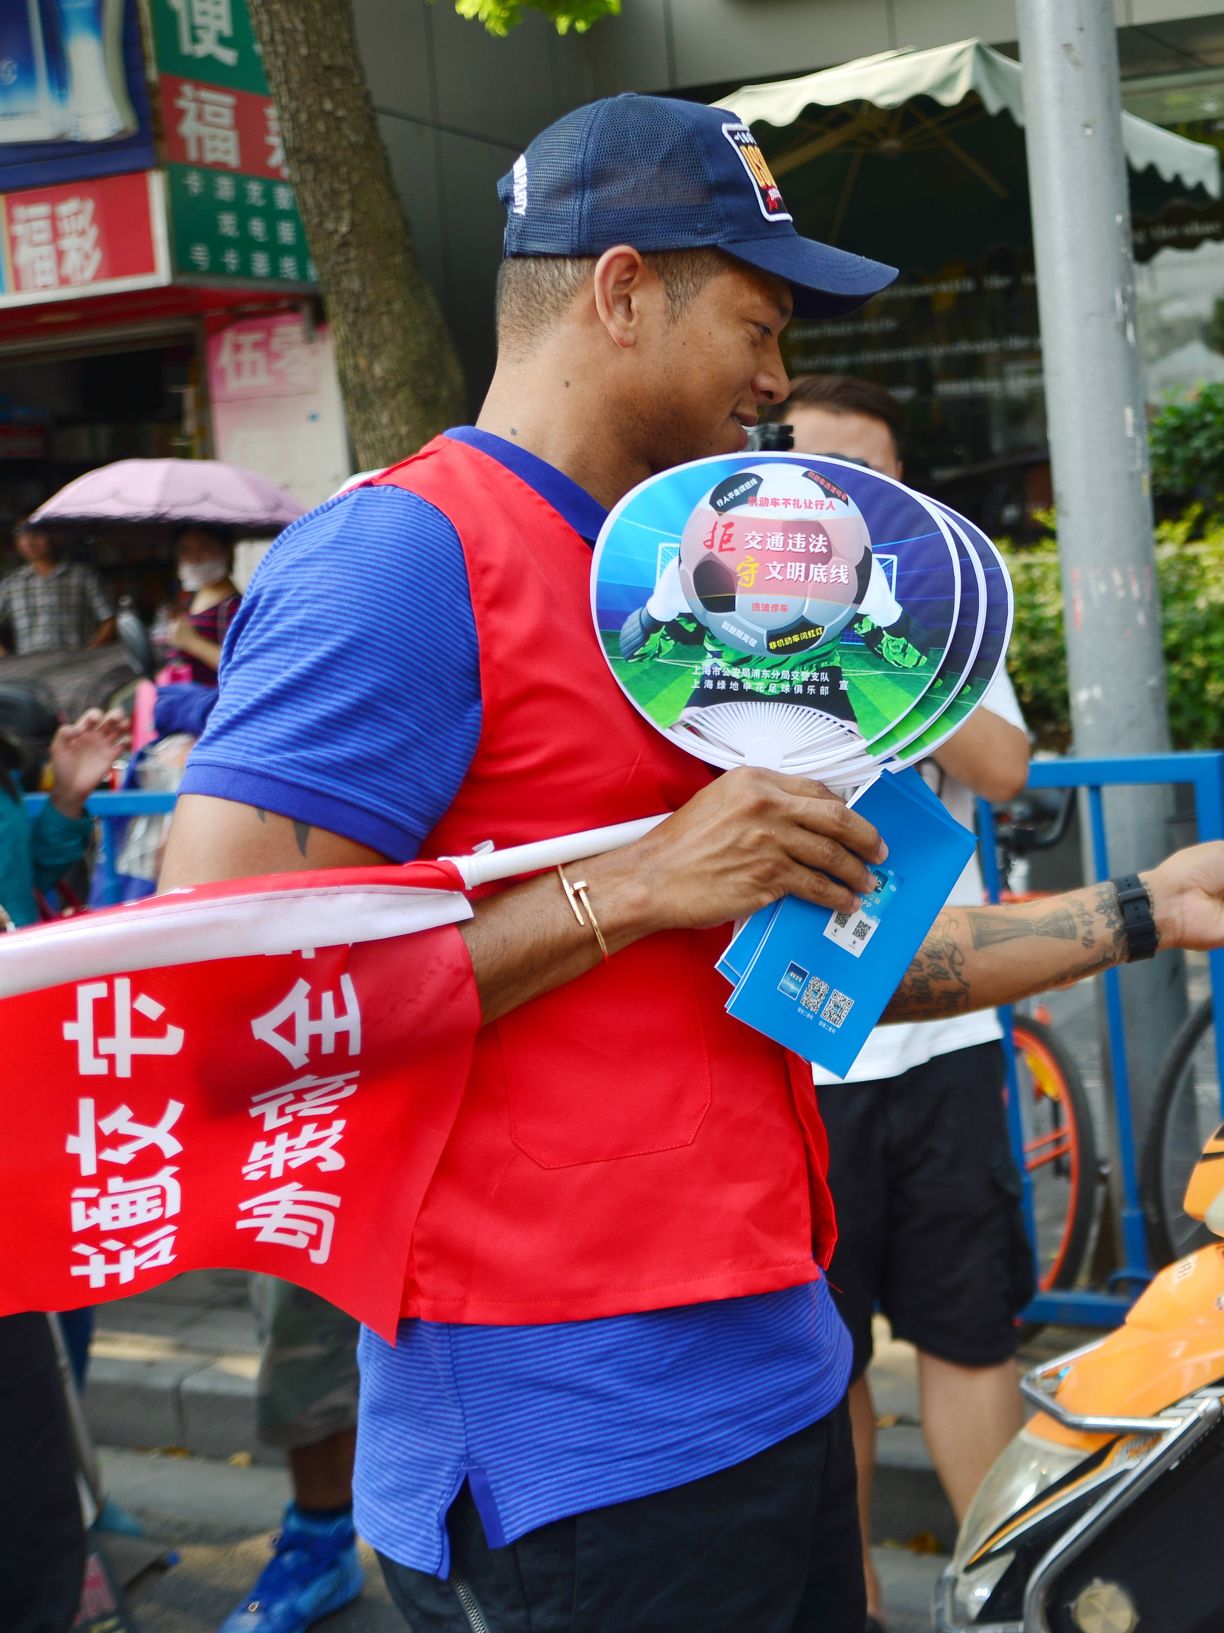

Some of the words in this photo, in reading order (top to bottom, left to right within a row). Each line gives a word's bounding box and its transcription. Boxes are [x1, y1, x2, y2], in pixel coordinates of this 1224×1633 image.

[11, 196, 103, 292] 福彩
[747, 495, 836, 512] 机动车不礼让行人
[703, 521, 737, 554] 拒
[744, 531, 829, 555] 交通违法
[736, 555, 759, 588] 守
[765, 560, 850, 585] 文明底线
